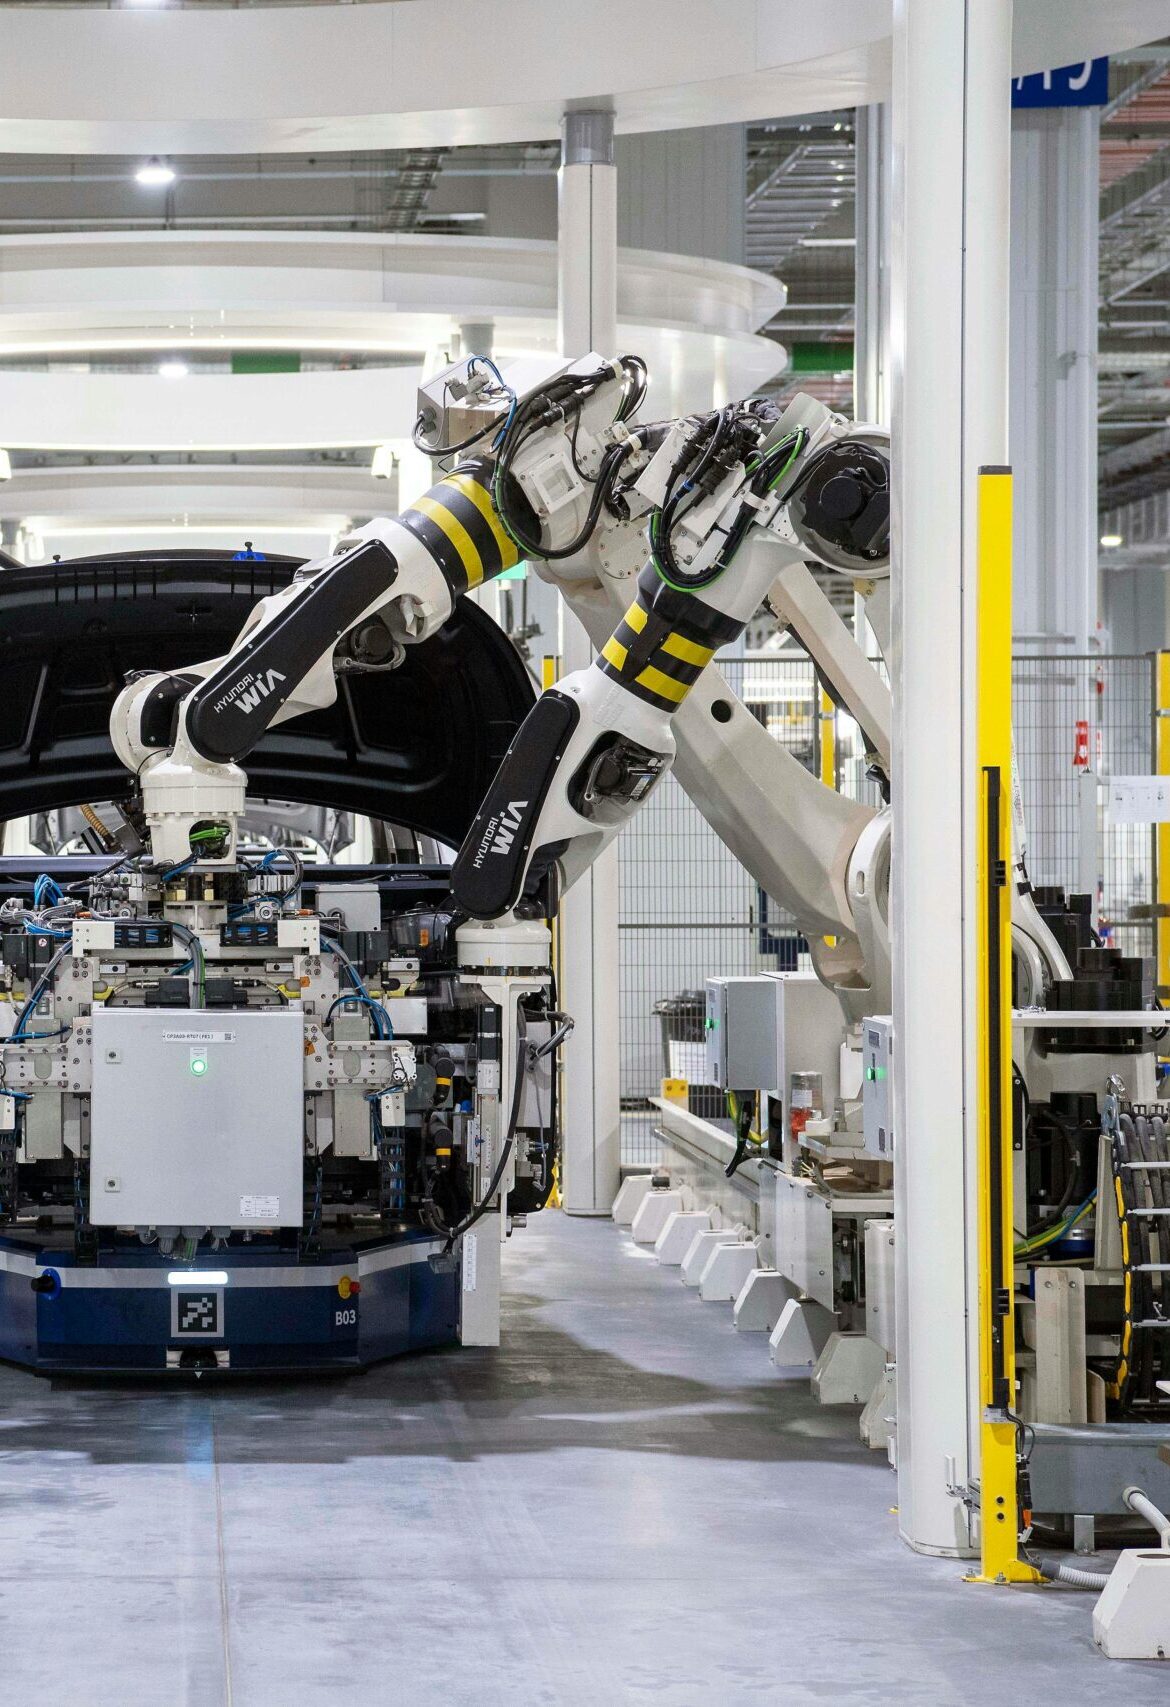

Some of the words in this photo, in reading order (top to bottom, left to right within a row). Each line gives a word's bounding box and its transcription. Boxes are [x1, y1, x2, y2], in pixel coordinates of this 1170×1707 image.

[213, 673, 254, 713] HYUNDAI
[473, 817, 499, 869] HYUNDAI
[335, 1309, 356, 1326] B03
